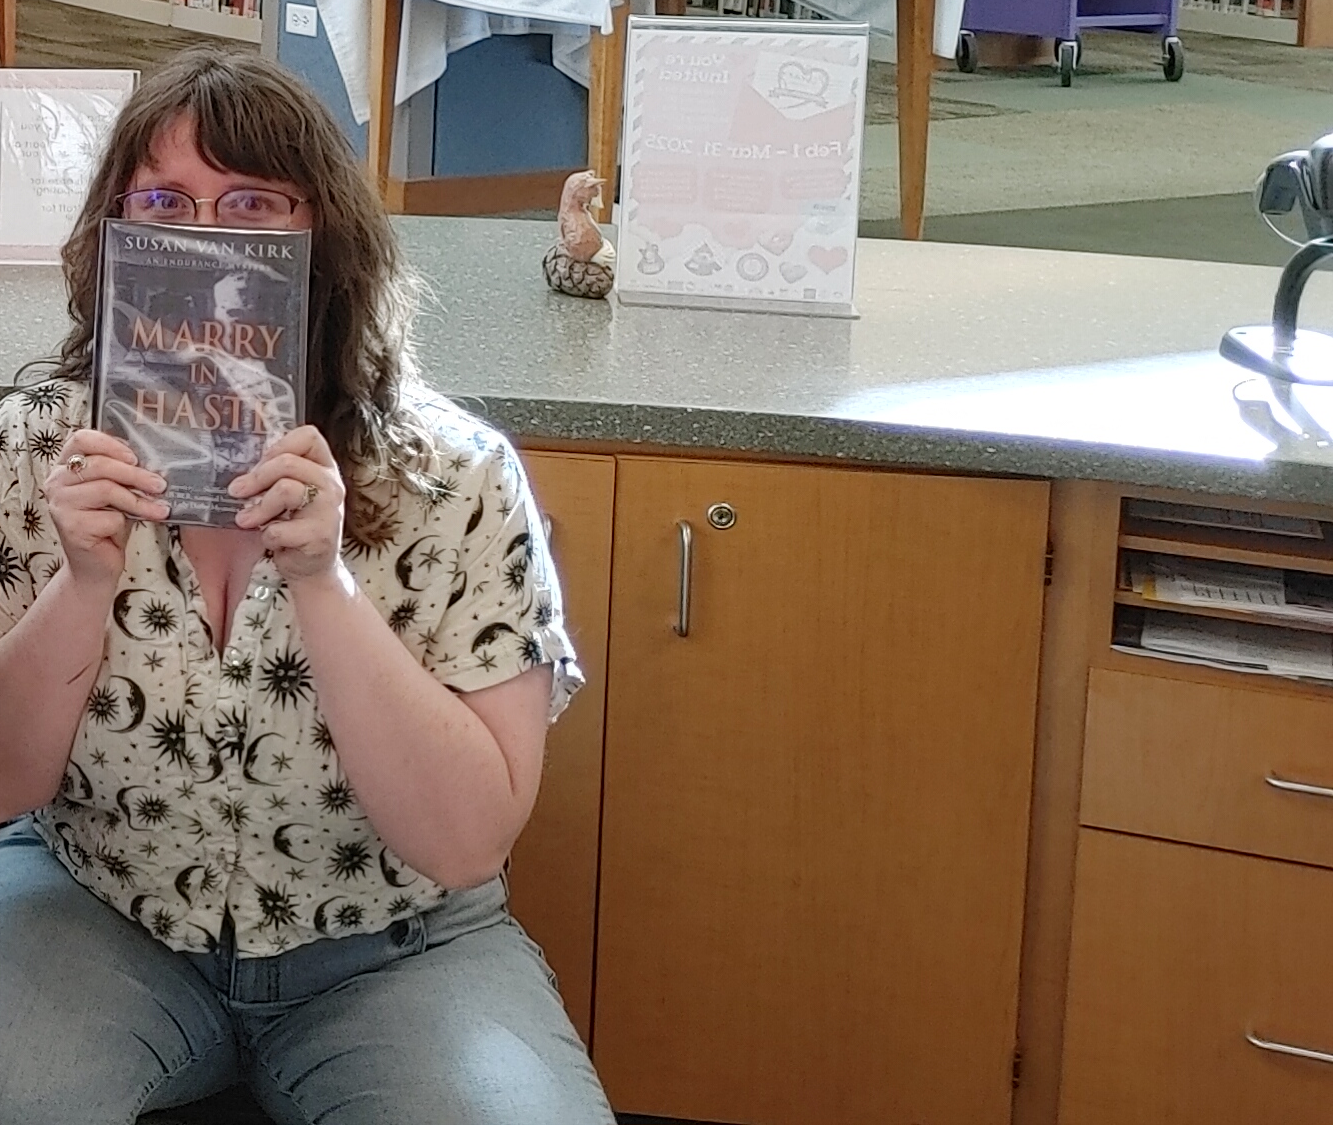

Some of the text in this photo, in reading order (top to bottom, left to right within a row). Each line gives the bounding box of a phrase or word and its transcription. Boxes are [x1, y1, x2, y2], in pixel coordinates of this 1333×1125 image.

[125, 236, 294, 259] SUSAN VAN KIRK
[146, 257, 159, 265] AN
[163, 258, 223, 269] ENDURANCE
[131, 316, 285, 360] MARRY
[189, 362, 219, 386] IN
